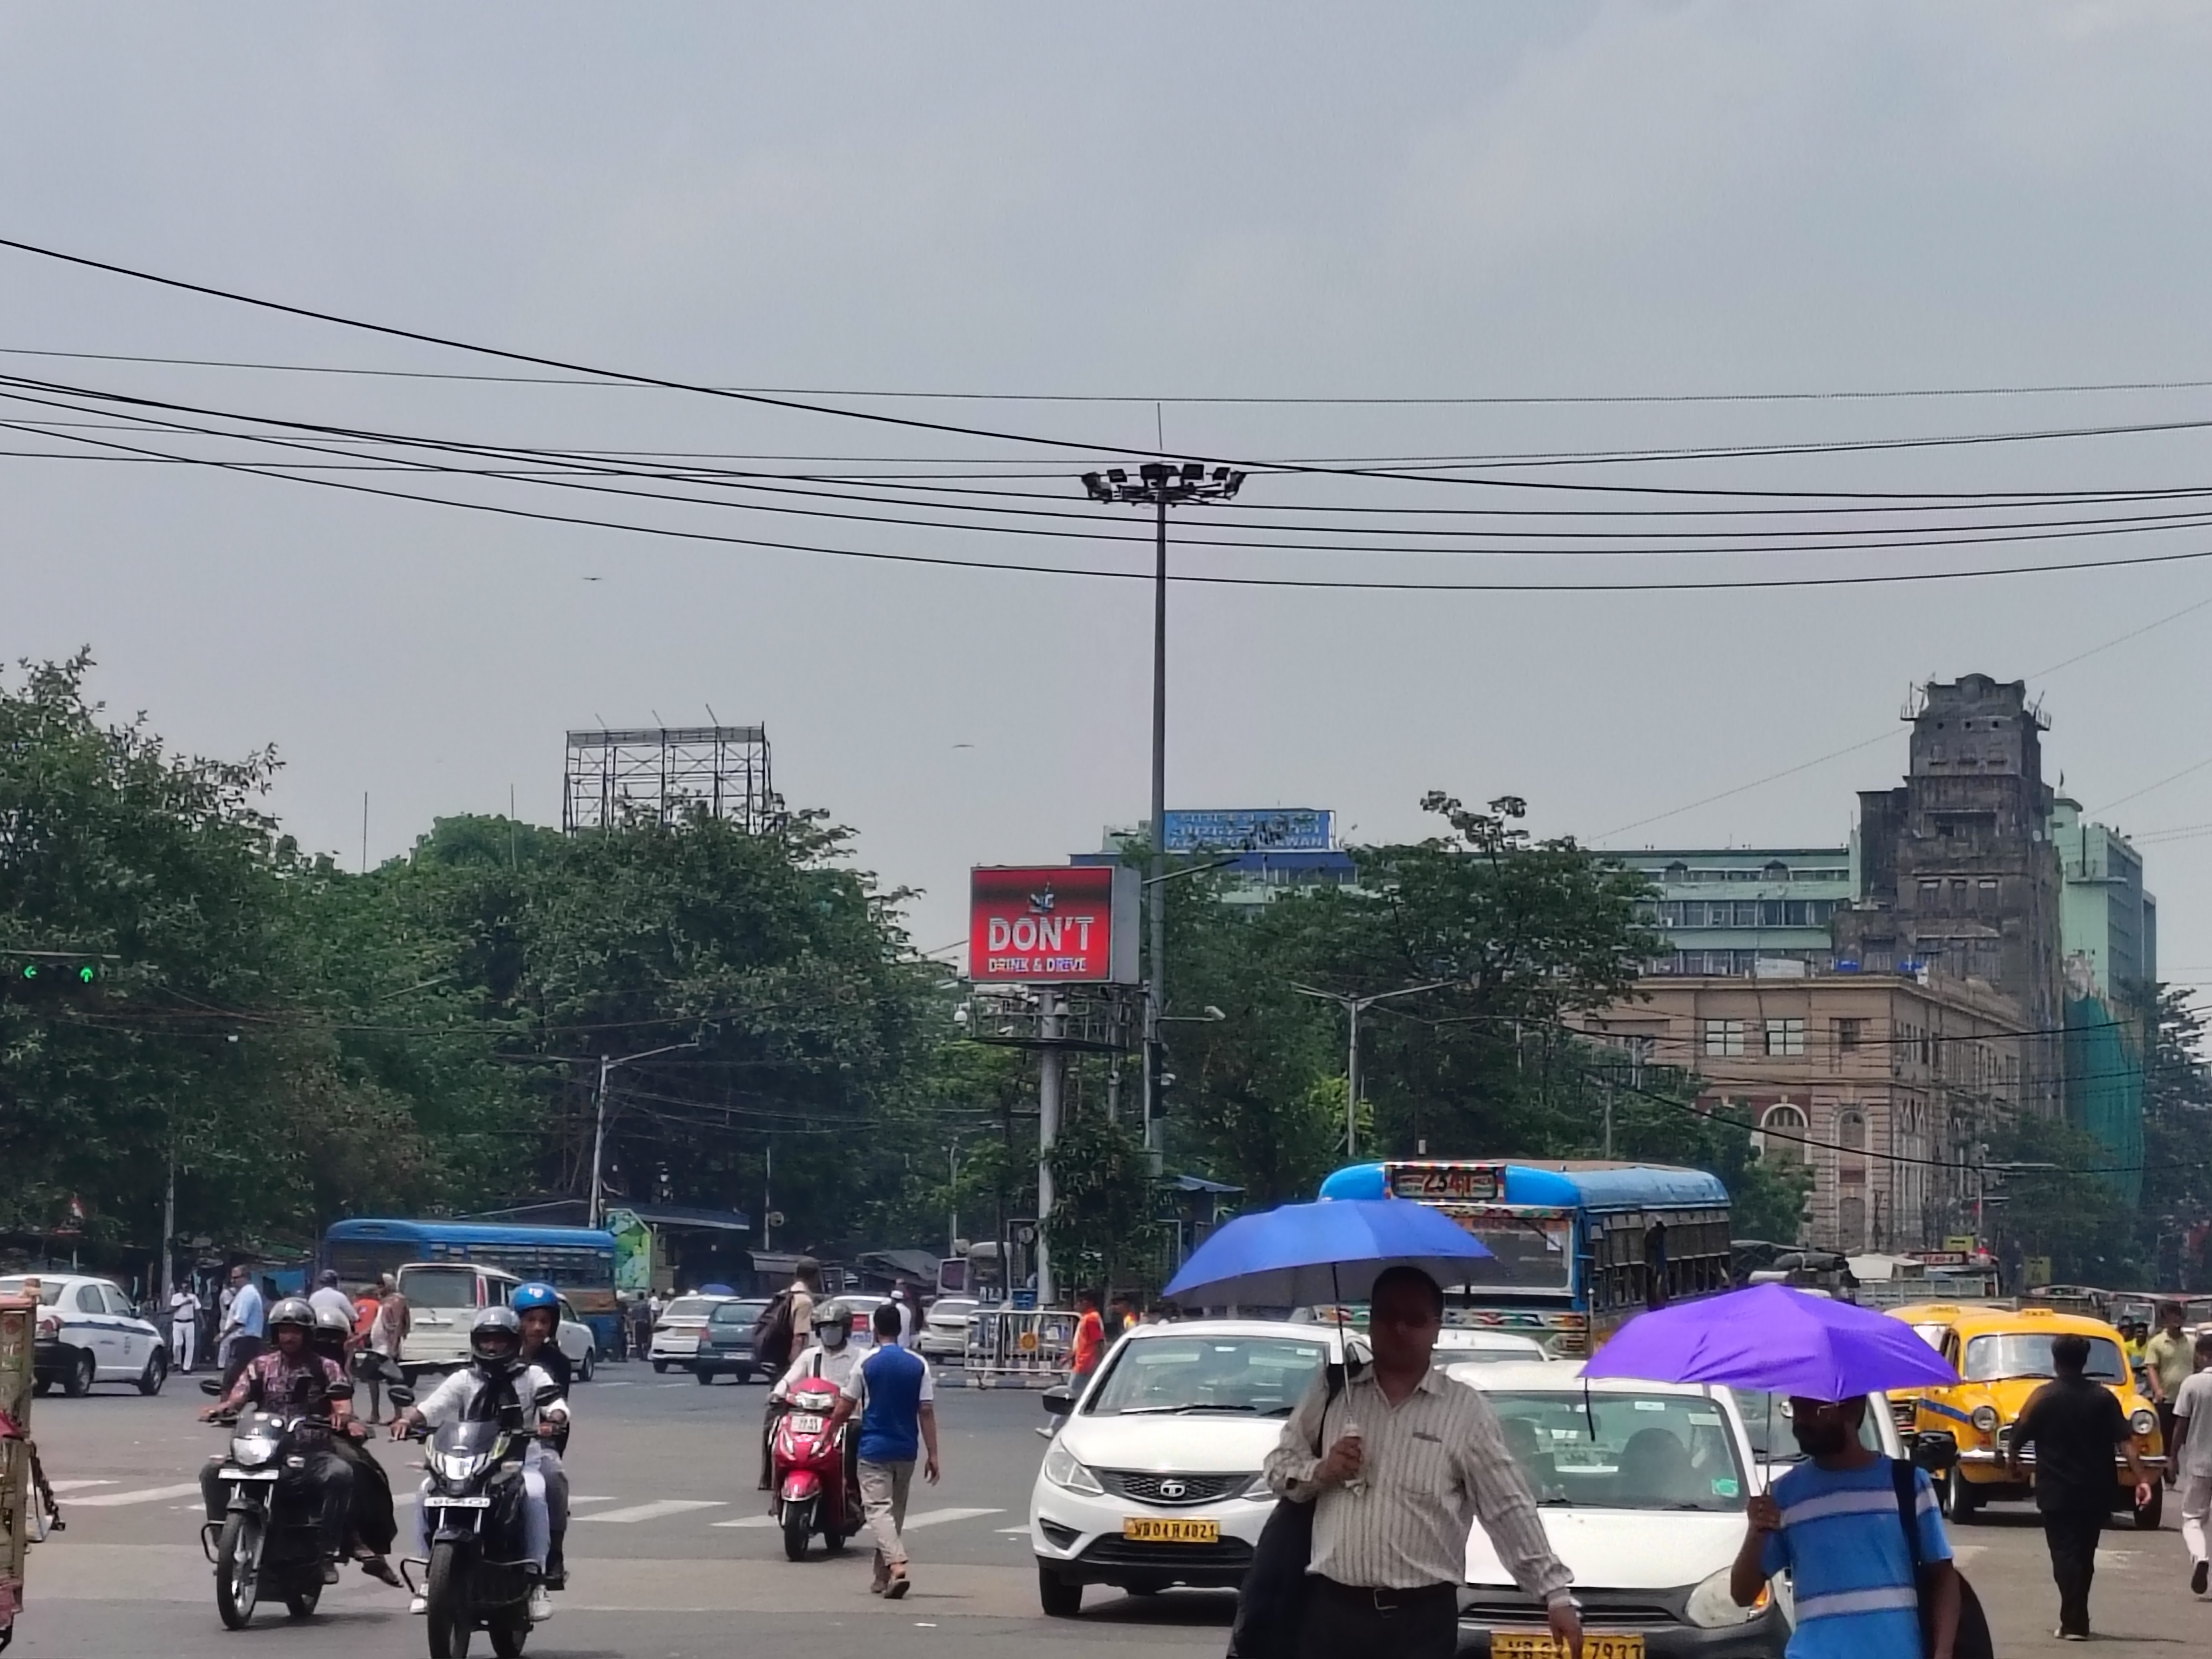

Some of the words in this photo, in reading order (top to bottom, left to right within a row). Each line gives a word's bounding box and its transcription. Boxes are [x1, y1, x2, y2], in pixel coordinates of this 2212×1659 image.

[988, 916, 1094, 951] DON'T
[989, 957, 1029, 973] DRINK
[1033, 957, 1042, 972] &
[1046, 957, 1087, 972] DRIVE
